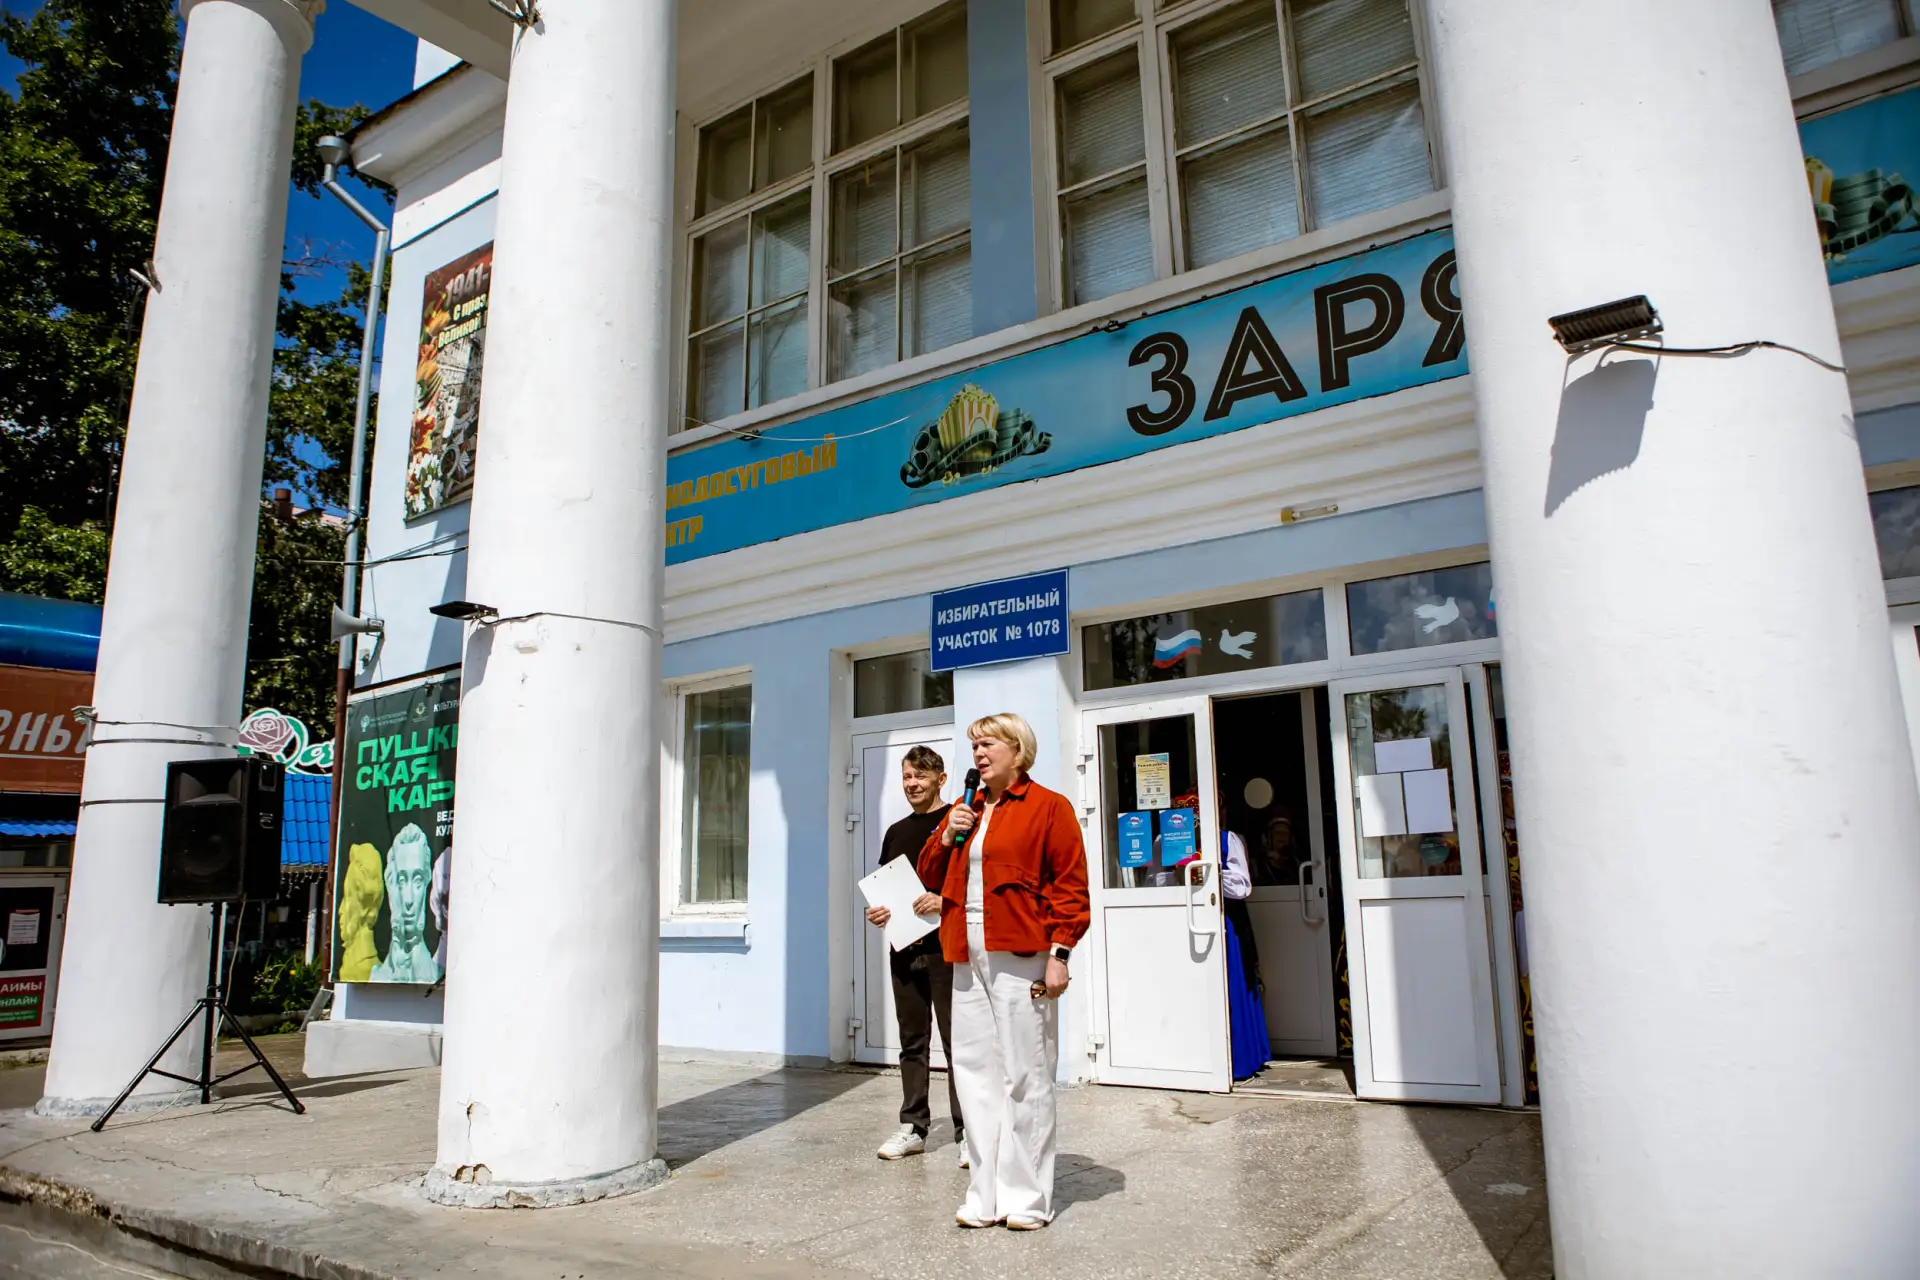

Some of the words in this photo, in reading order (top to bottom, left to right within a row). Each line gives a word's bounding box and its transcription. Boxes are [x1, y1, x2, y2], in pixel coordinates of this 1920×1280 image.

[445, 261, 492, 310] 1941-
[461, 293, 488, 318] праз
[1126, 248, 1467, 436] ЗАРЯ
[937, 588, 1060, 625] ИЗБИРАТЕЛЬНЫЙ
[937, 628, 998, 652] УЧАСТОК
[1005, 625, 1022, 641] №
[1026, 618, 1060, 638] 1078
[356, 754, 438, 791] СКАЯ
[387, 780, 455, 813] КАР
